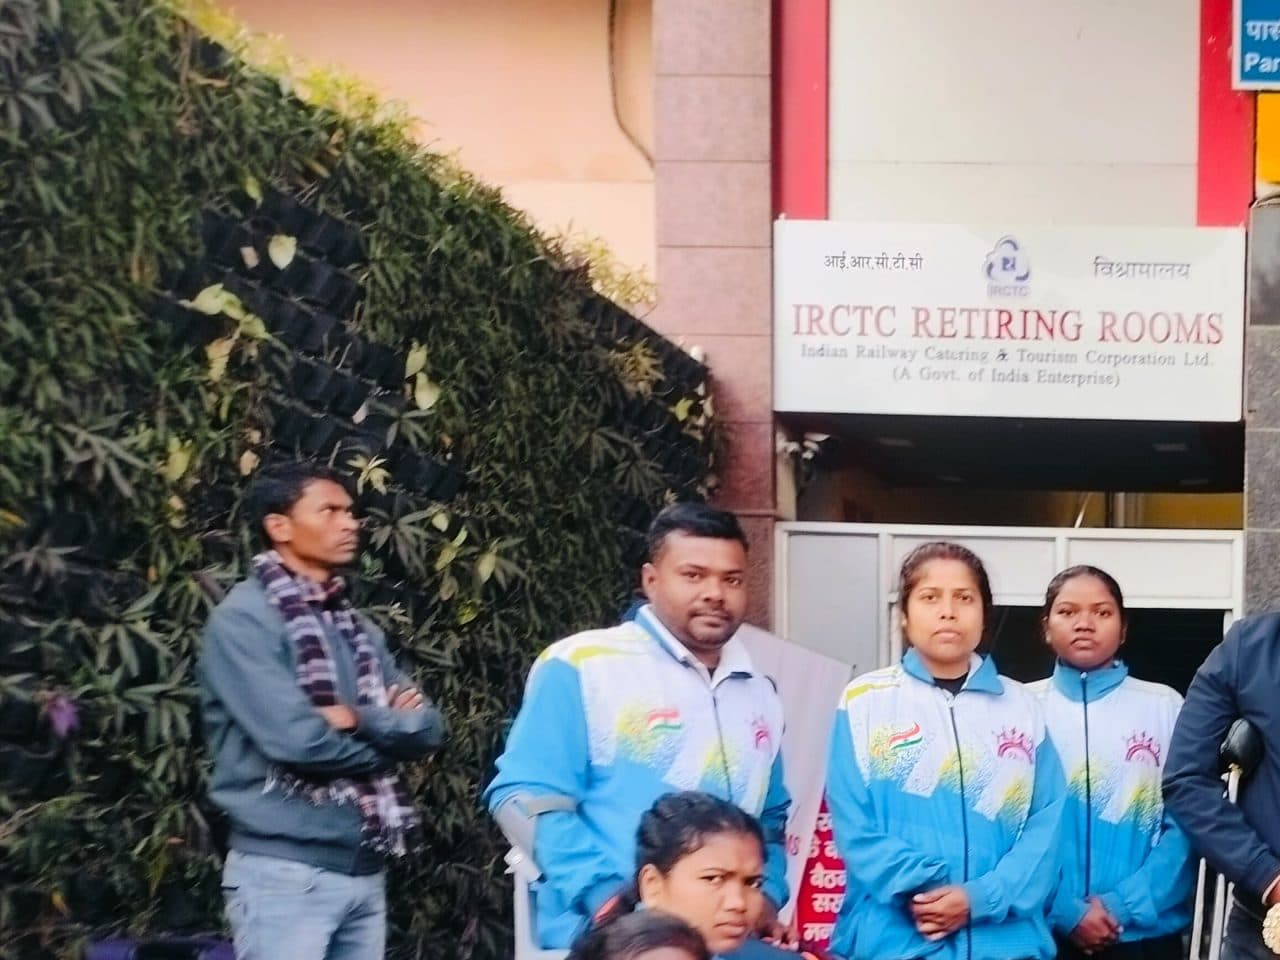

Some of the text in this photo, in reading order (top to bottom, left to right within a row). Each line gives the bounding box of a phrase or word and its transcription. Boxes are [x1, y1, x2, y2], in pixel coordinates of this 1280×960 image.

[792, 304, 1225, 346] IRCTC RETIRING ROOMS
[801, 344, 1214, 368] Indian Railway Catering & Tourism Corporation Ltd.
[892, 367, 1120, 388] (A Govt. of India Enterprise)
